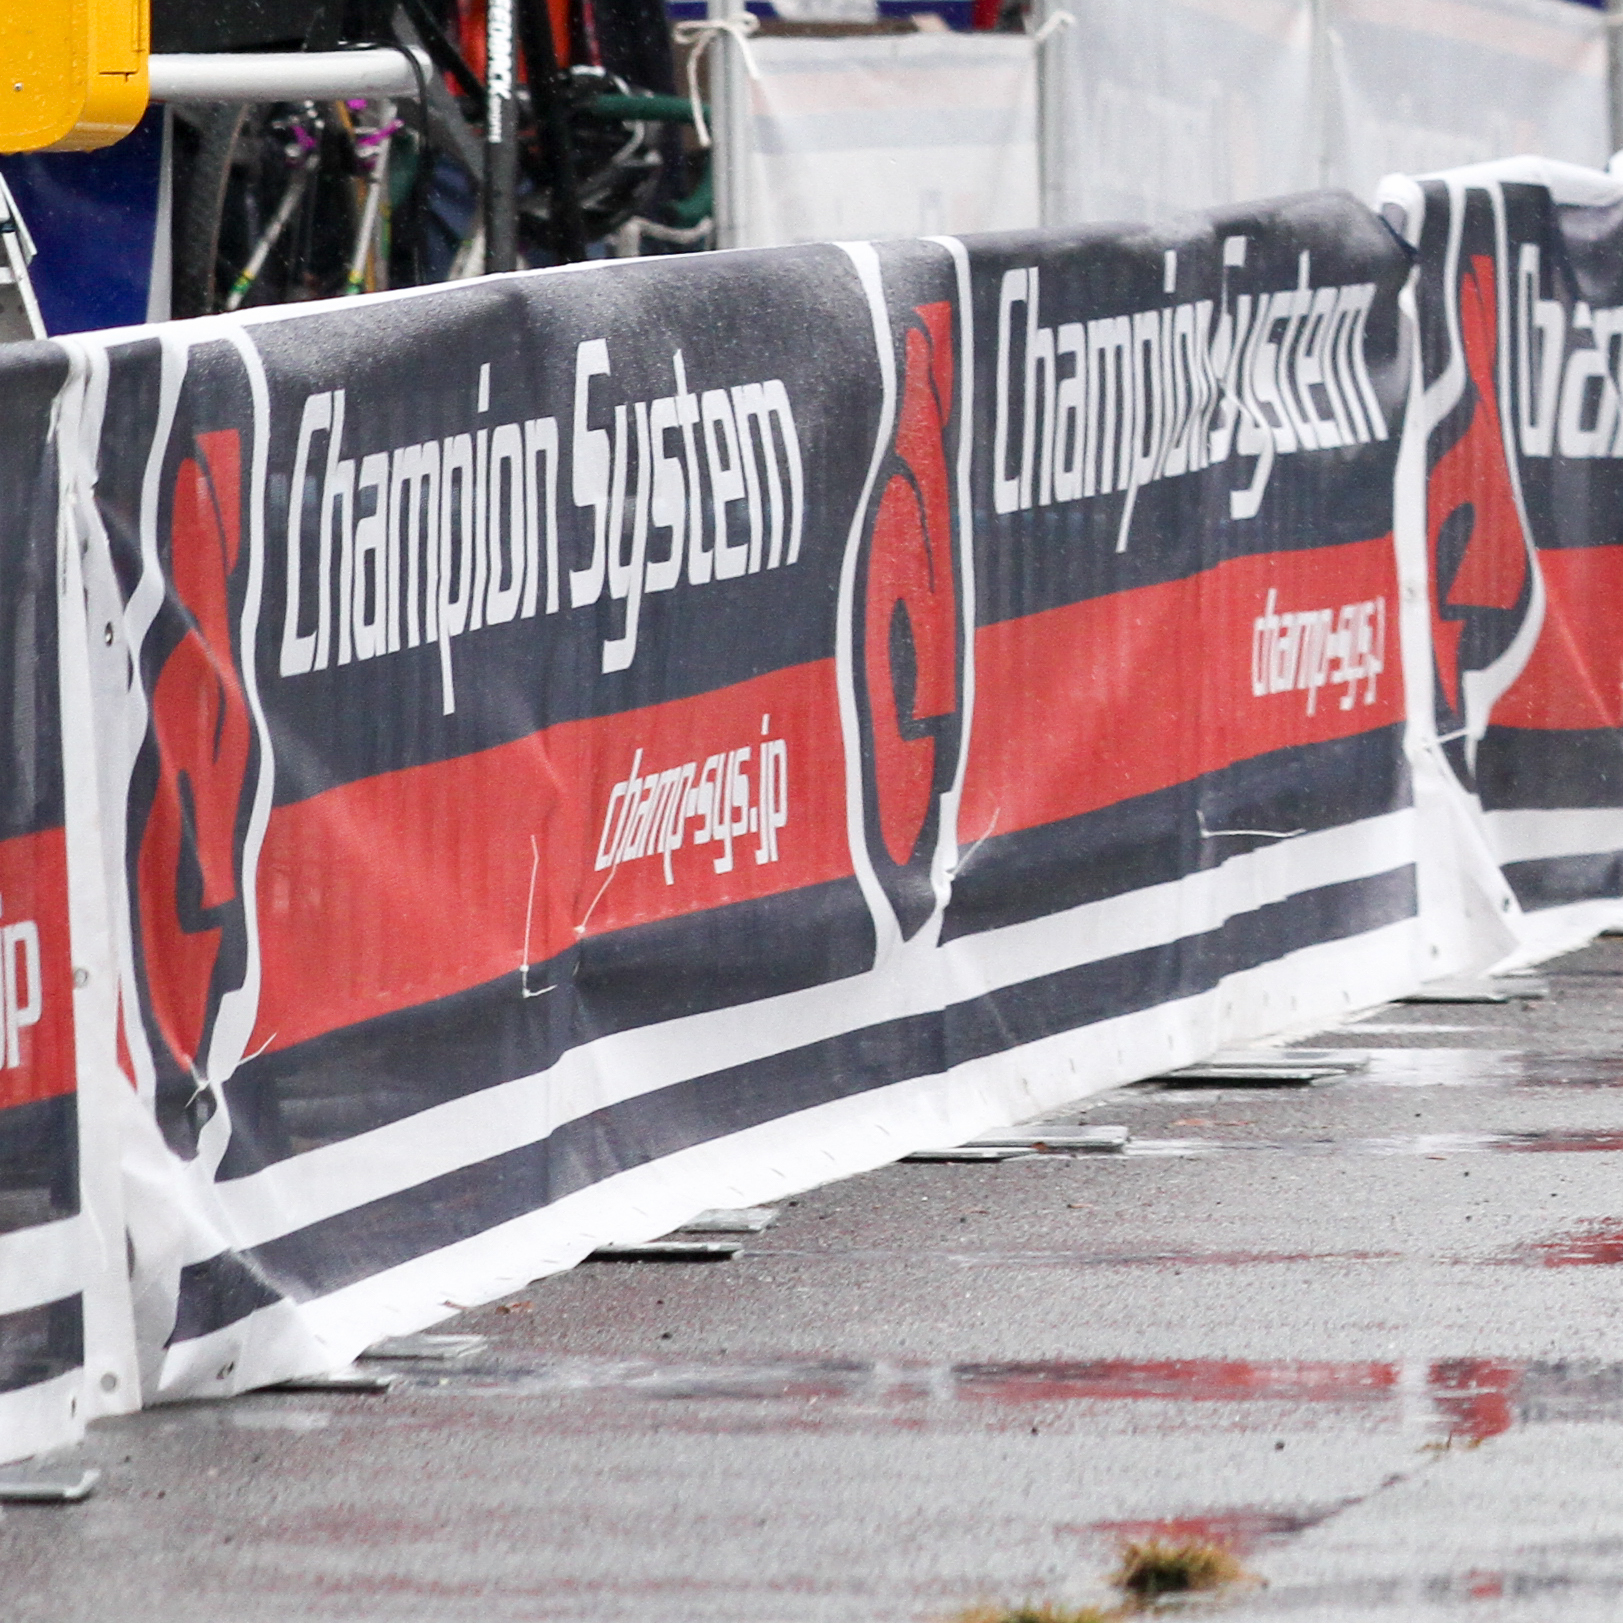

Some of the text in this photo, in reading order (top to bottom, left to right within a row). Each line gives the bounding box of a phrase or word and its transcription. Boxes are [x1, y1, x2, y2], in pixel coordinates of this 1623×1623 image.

[279, 337, 804, 716] Champion System
[994, 249, 1216, 553] Champion
[594, 713, 788, 886] champ-sys.jp
